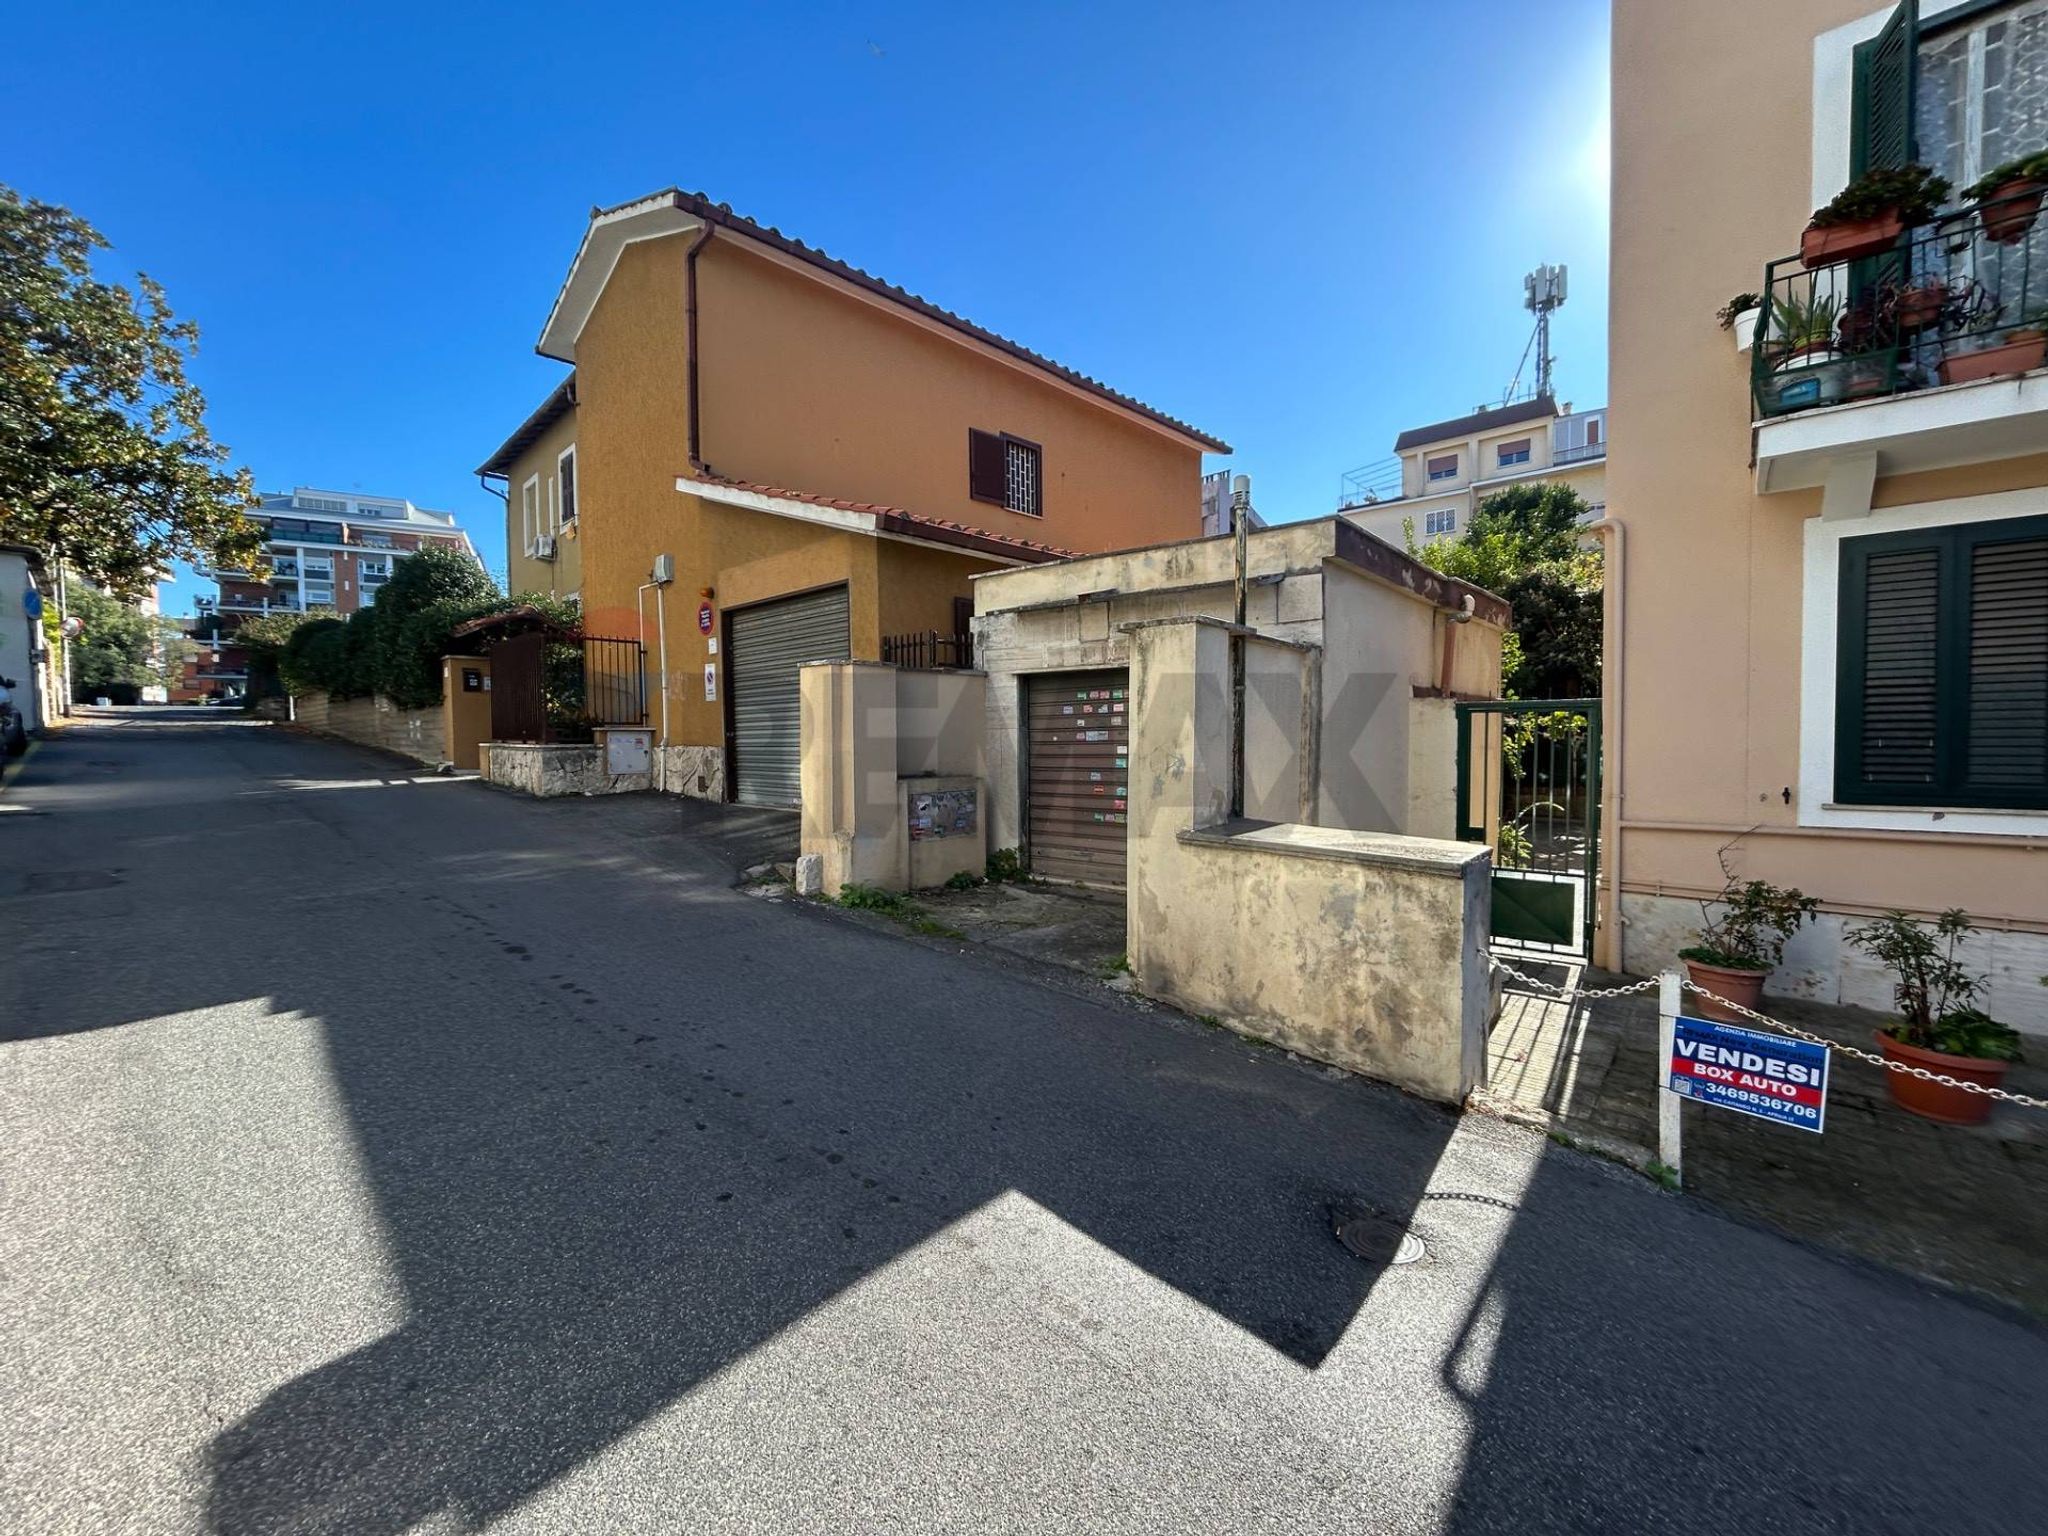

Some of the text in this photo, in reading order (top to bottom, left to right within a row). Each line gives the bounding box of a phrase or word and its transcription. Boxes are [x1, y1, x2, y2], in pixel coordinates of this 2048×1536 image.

[1714, 1026, 1746, 1036] AGENZIA
[1747, 1032, 1796, 1047] IMMOBILIARE
[1676, 1039, 1820, 1086] VENDESI
[1694, 1063, 1797, 1096] BOX AUTO
[1706, 1083, 1817, 1119] 3469536706
